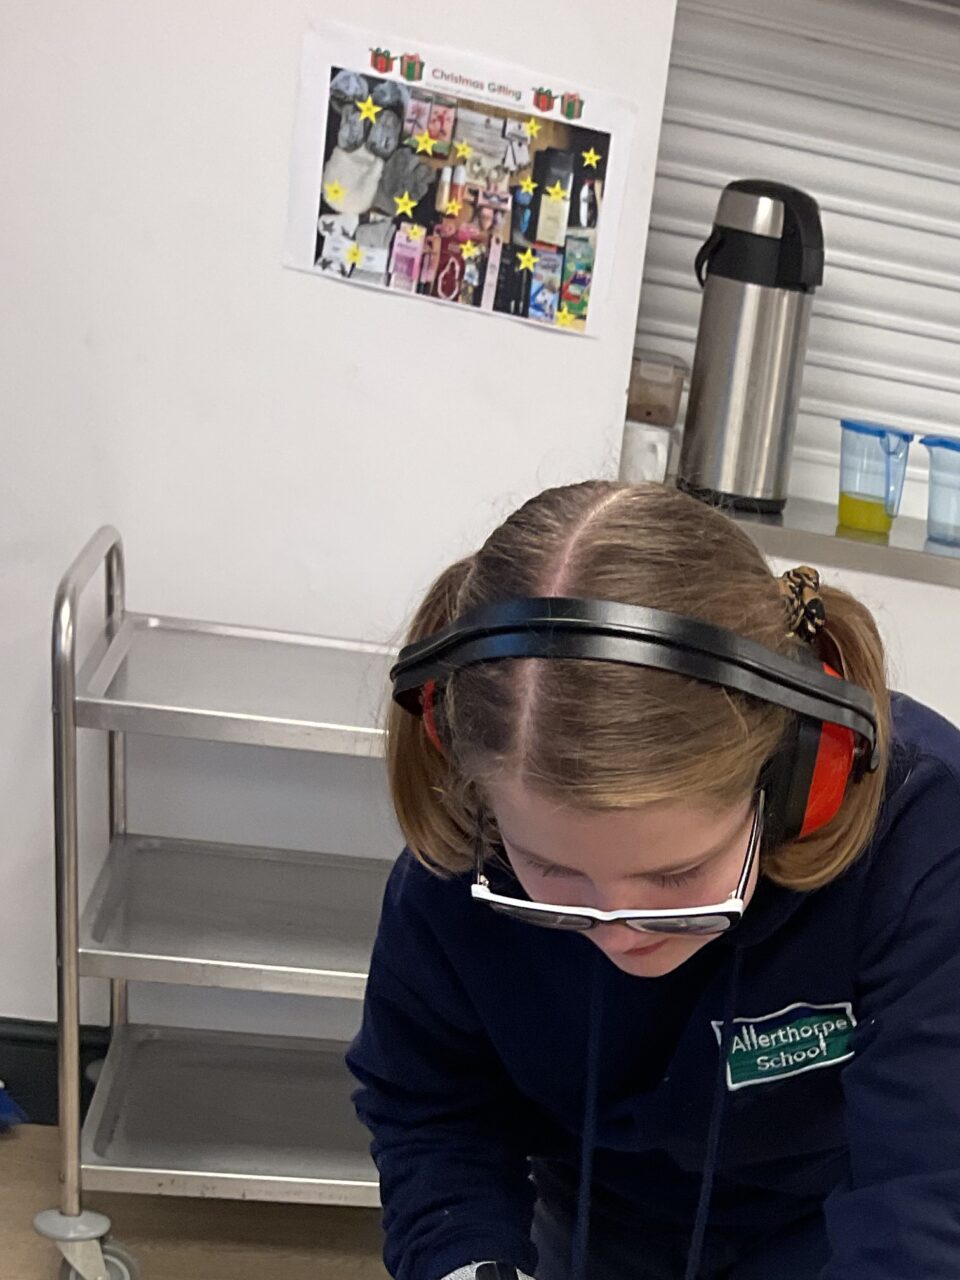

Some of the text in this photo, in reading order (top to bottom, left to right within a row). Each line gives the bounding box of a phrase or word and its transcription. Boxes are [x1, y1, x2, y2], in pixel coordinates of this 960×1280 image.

[431, 68, 485, 91] Christmas
[487, 82, 522, 101] Gifting
[731, 1018, 848, 1054] Allerthorpe
[756, 1032, 827, 1071] School
